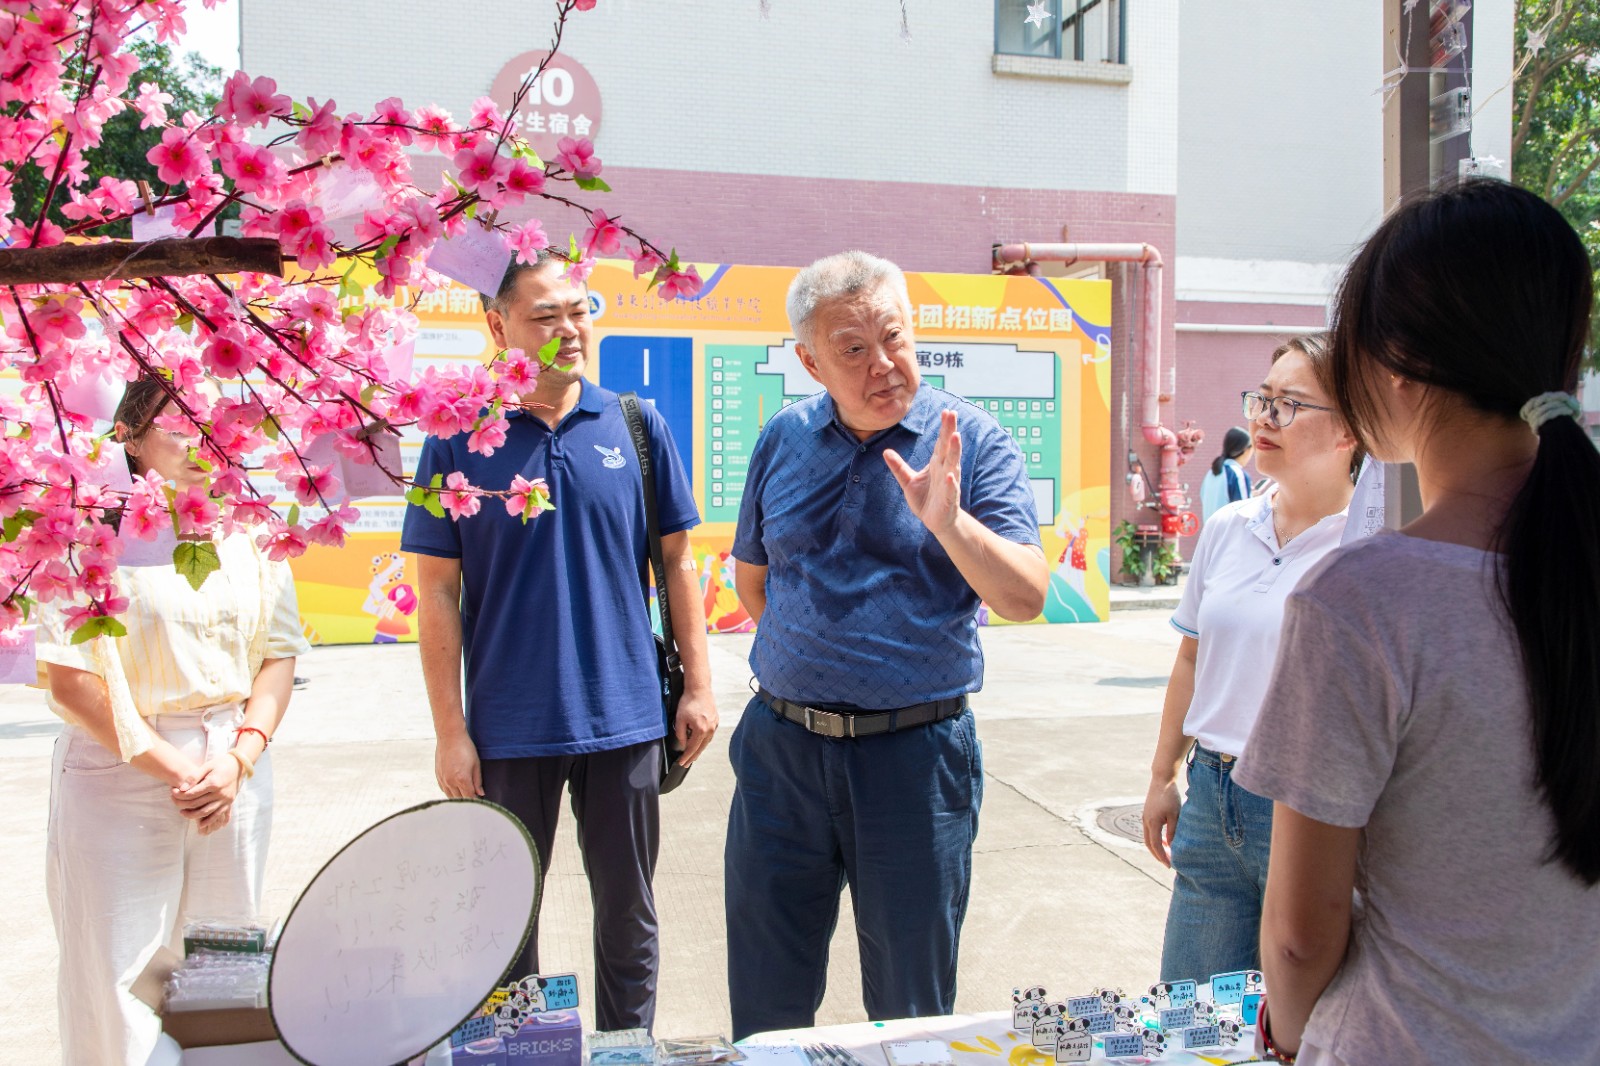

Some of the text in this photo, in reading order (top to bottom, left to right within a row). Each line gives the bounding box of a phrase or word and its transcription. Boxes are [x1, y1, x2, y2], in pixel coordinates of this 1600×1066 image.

[520, 66, 574, 106] 10
[916, 350, 964, 369] 寓9栋
[507, 1038, 573, 1056] BRICKS
